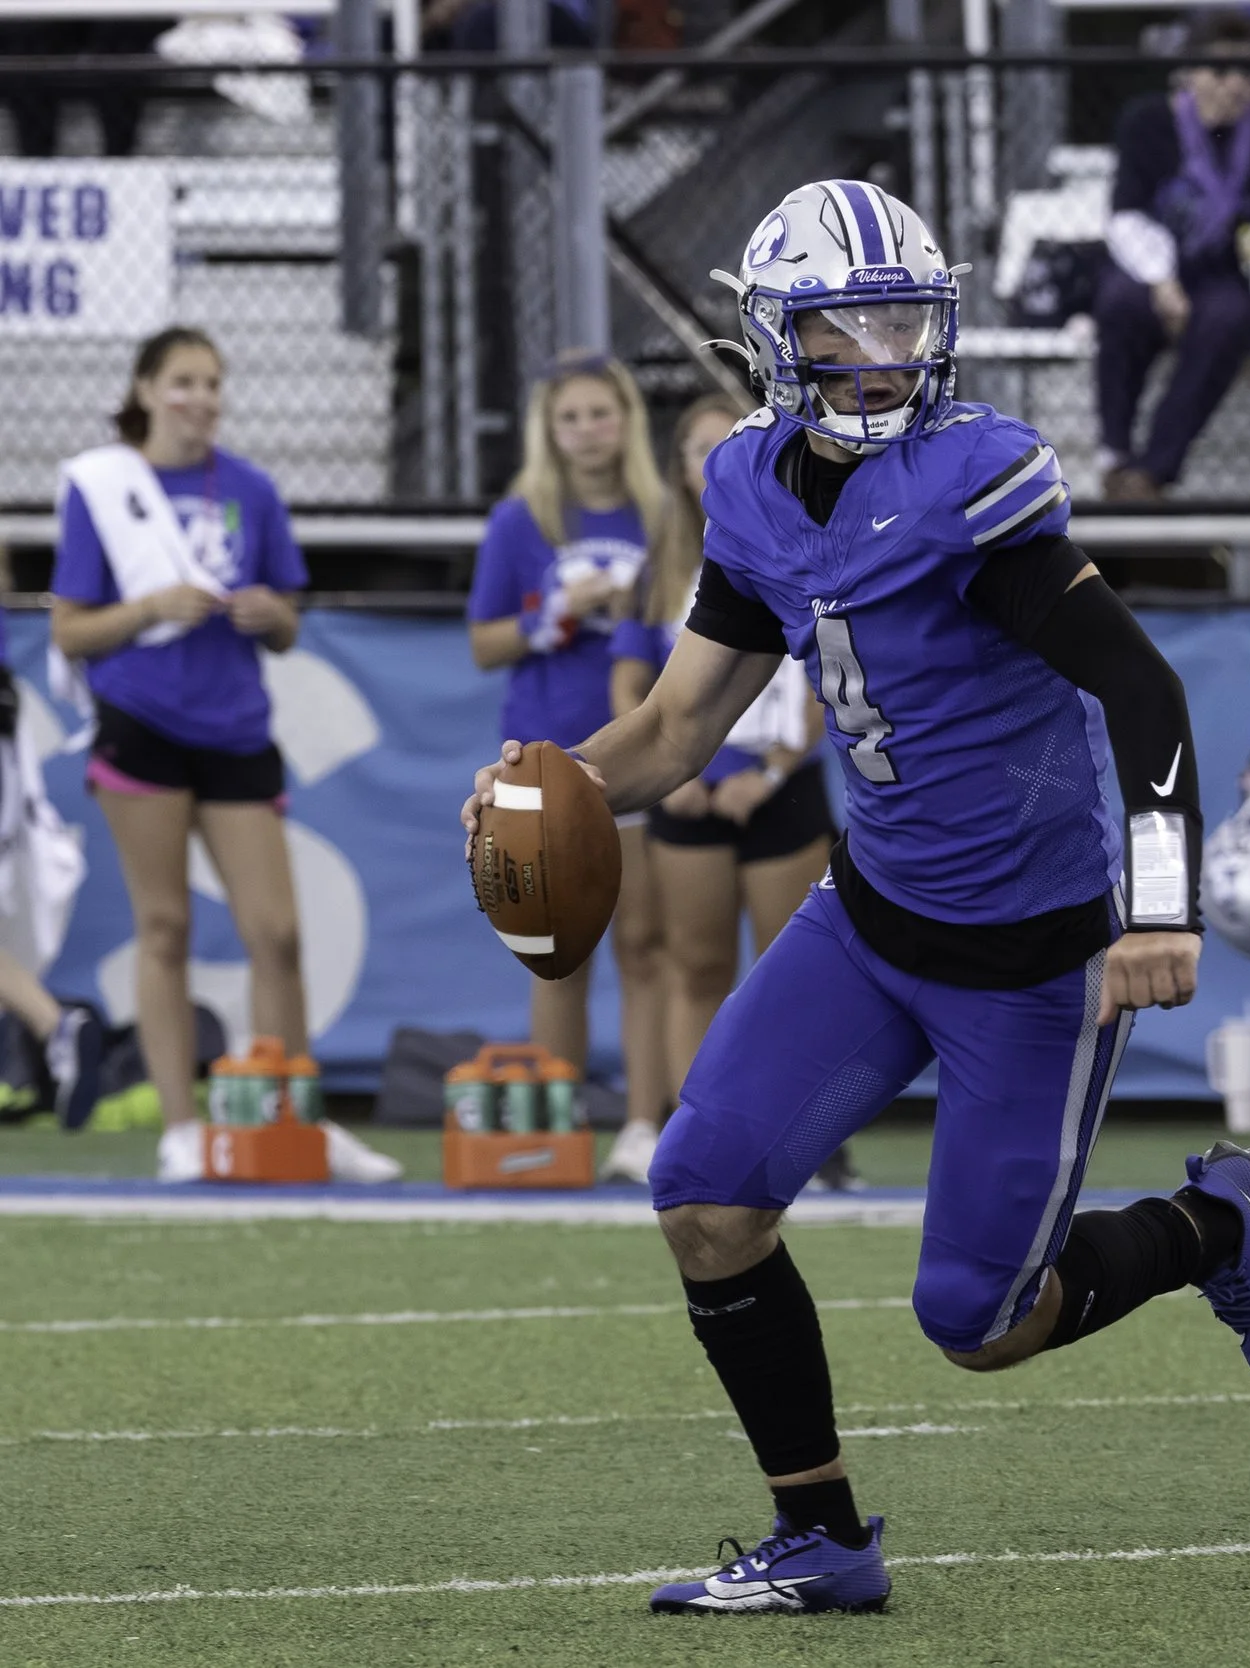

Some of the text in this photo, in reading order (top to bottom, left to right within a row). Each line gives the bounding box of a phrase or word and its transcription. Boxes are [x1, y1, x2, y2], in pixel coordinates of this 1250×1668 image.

[855, 269, 905, 285] Vikings
[814, 616, 902, 785] 4
[481, 832, 500, 913] Wilson
[503, 849, 521, 905] GST
[522, 862, 536, 896] NCAA
